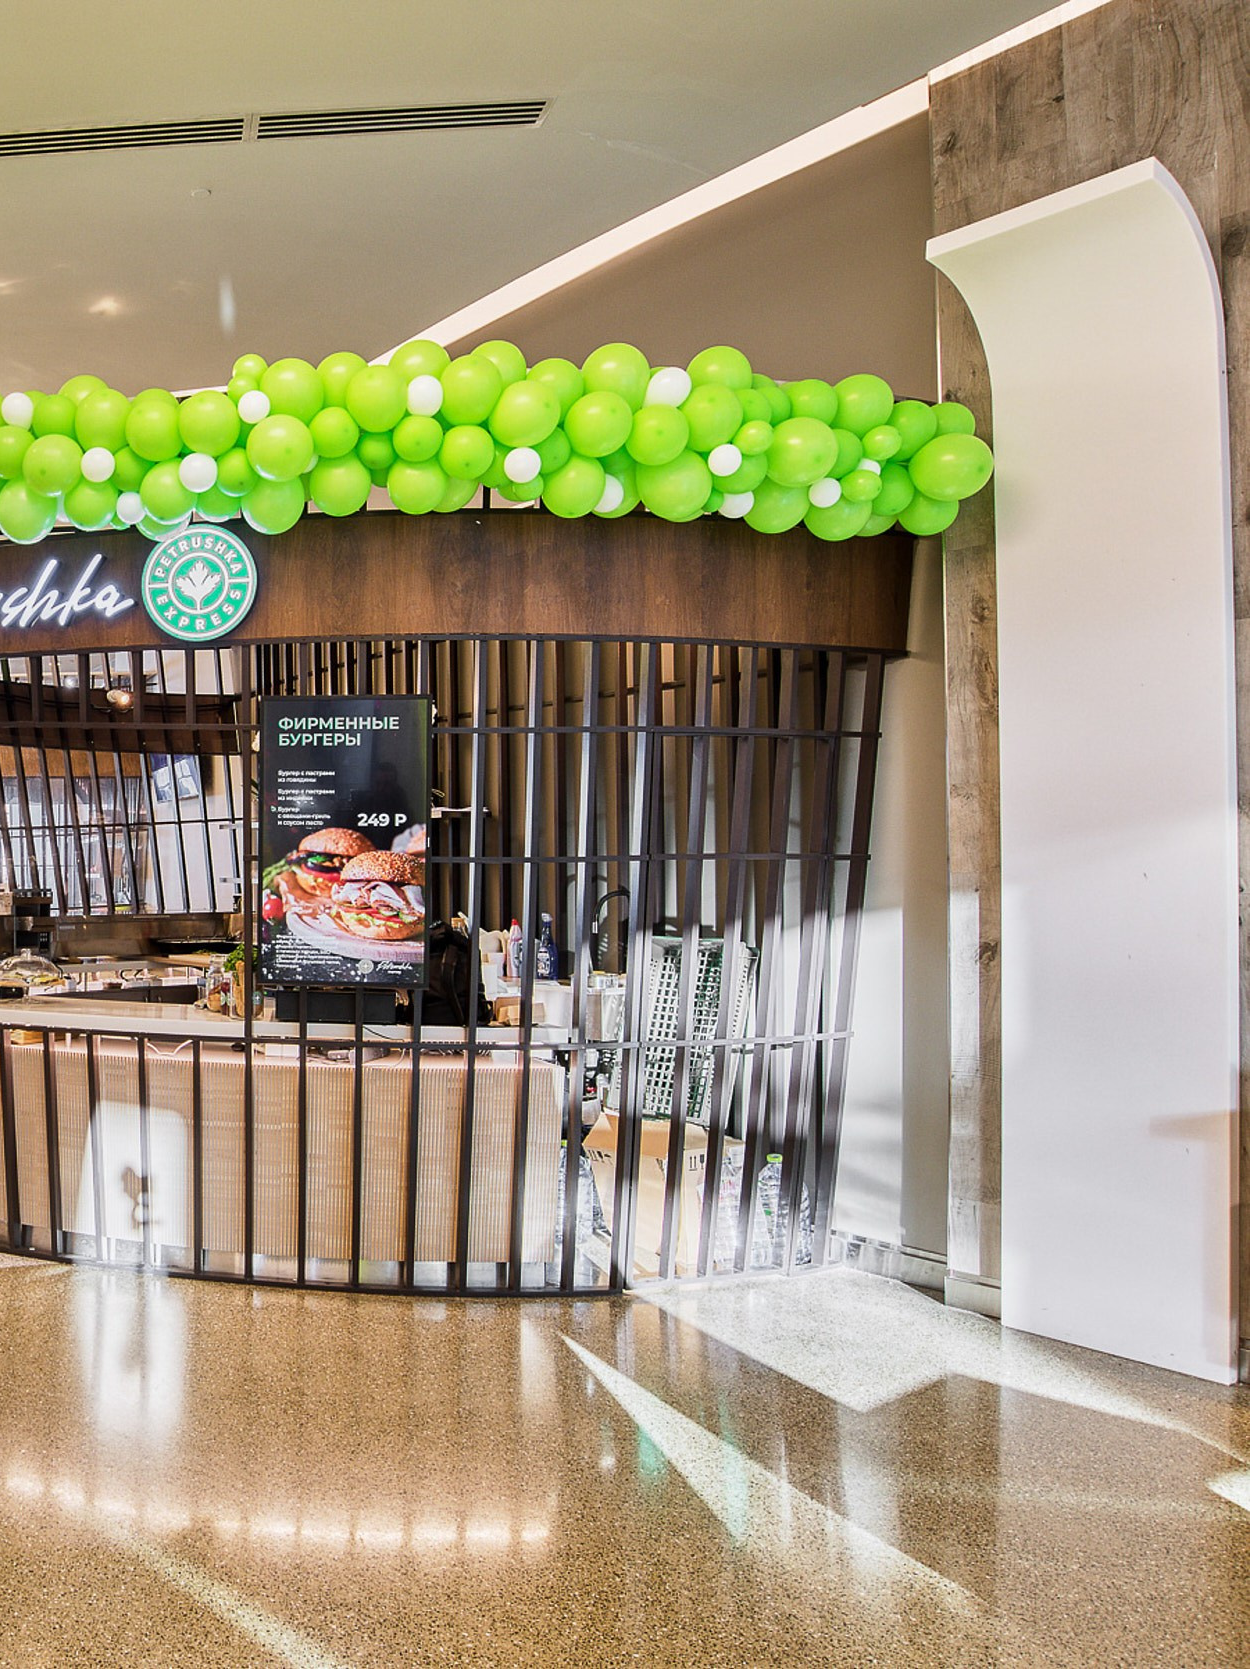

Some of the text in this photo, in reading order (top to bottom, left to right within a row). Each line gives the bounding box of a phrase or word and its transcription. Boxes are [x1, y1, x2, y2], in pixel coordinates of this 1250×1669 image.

[154, 536, 243, 578] PETRUSHKA
[156, 589, 242, 631] EXPRESS
[278, 717, 400, 730] ФИРМЕННЫЕ
[278, 733, 361, 746] БУРГЕРЫ
[357, 813, 390, 827] 249
